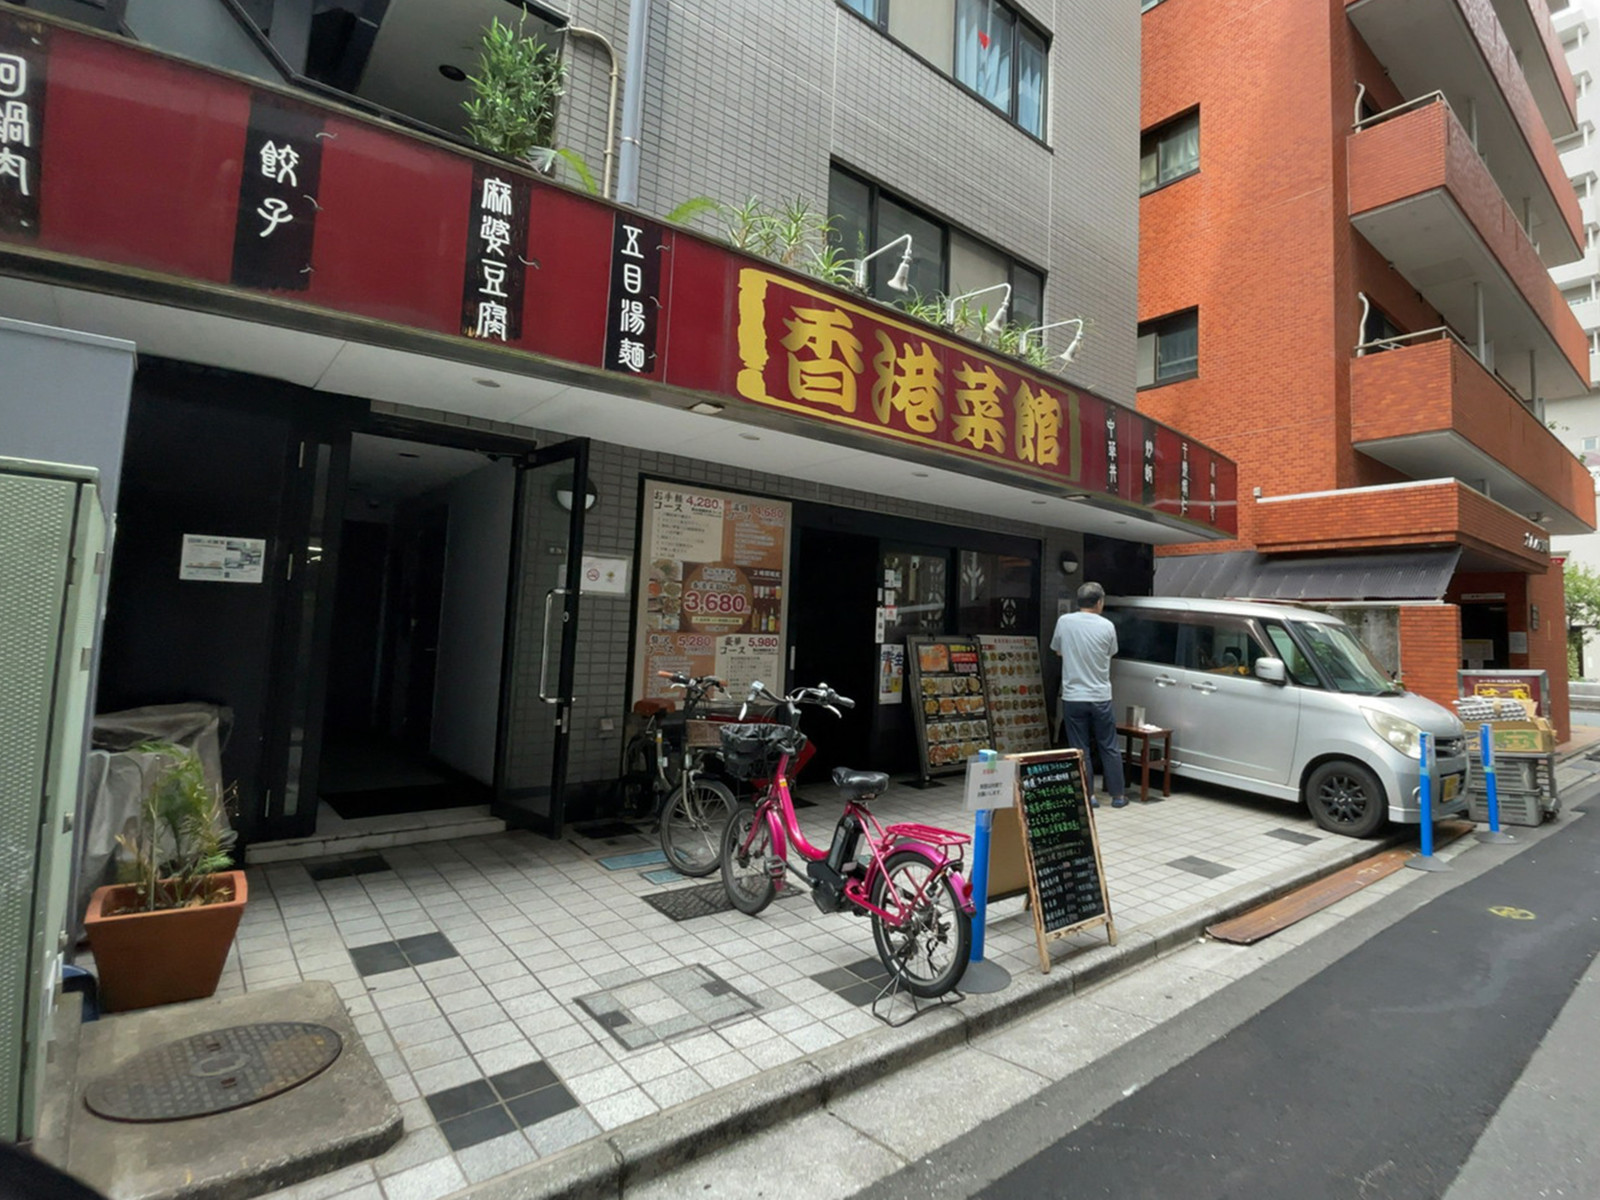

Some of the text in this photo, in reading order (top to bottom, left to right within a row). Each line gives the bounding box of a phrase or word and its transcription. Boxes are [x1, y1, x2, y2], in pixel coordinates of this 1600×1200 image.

[257, 140, 300, 238] 餃子
[476, 176, 512, 342] 麻婆豆腐
[780, 306, 1063, 467] 香港菜館
[654, 501, 683, 513] コース
[686, 495, 719, 510] 4,280
[678, 636, 712, 647] 5,280
[748, 637, 778, 648] 5,980
[720, 646, 746, 655] コース
